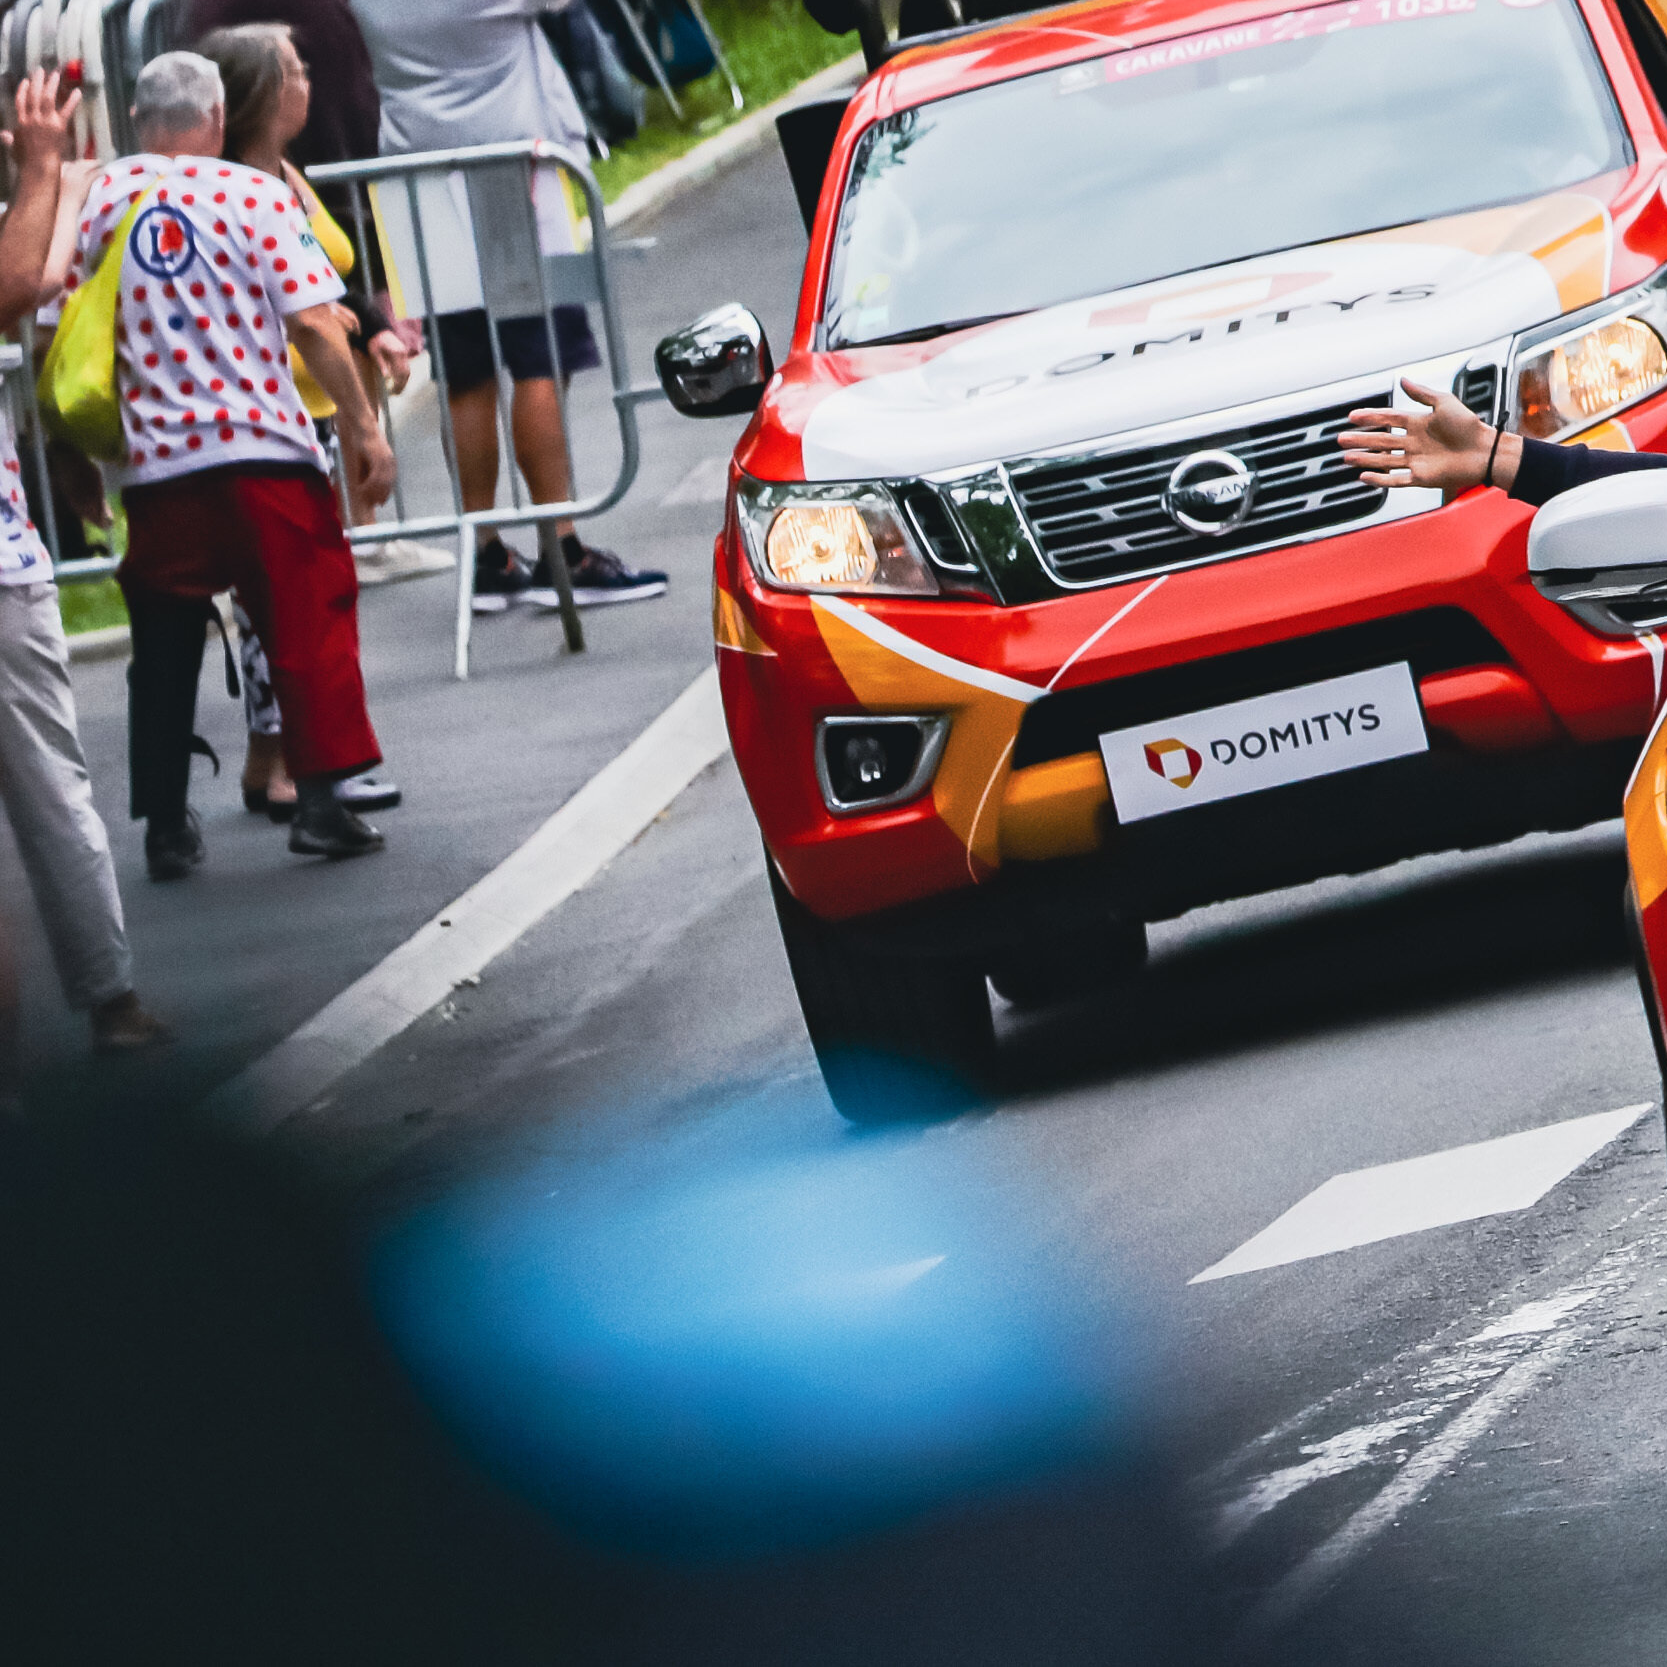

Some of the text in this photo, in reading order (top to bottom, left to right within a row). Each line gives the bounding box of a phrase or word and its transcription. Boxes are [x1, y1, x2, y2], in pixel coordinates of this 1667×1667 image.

[1115, 27, 1262, 74] CARAVANE
[965, 283, 1439, 399] DOMITYS
[1210, 703, 1381, 765] DOMITYS
